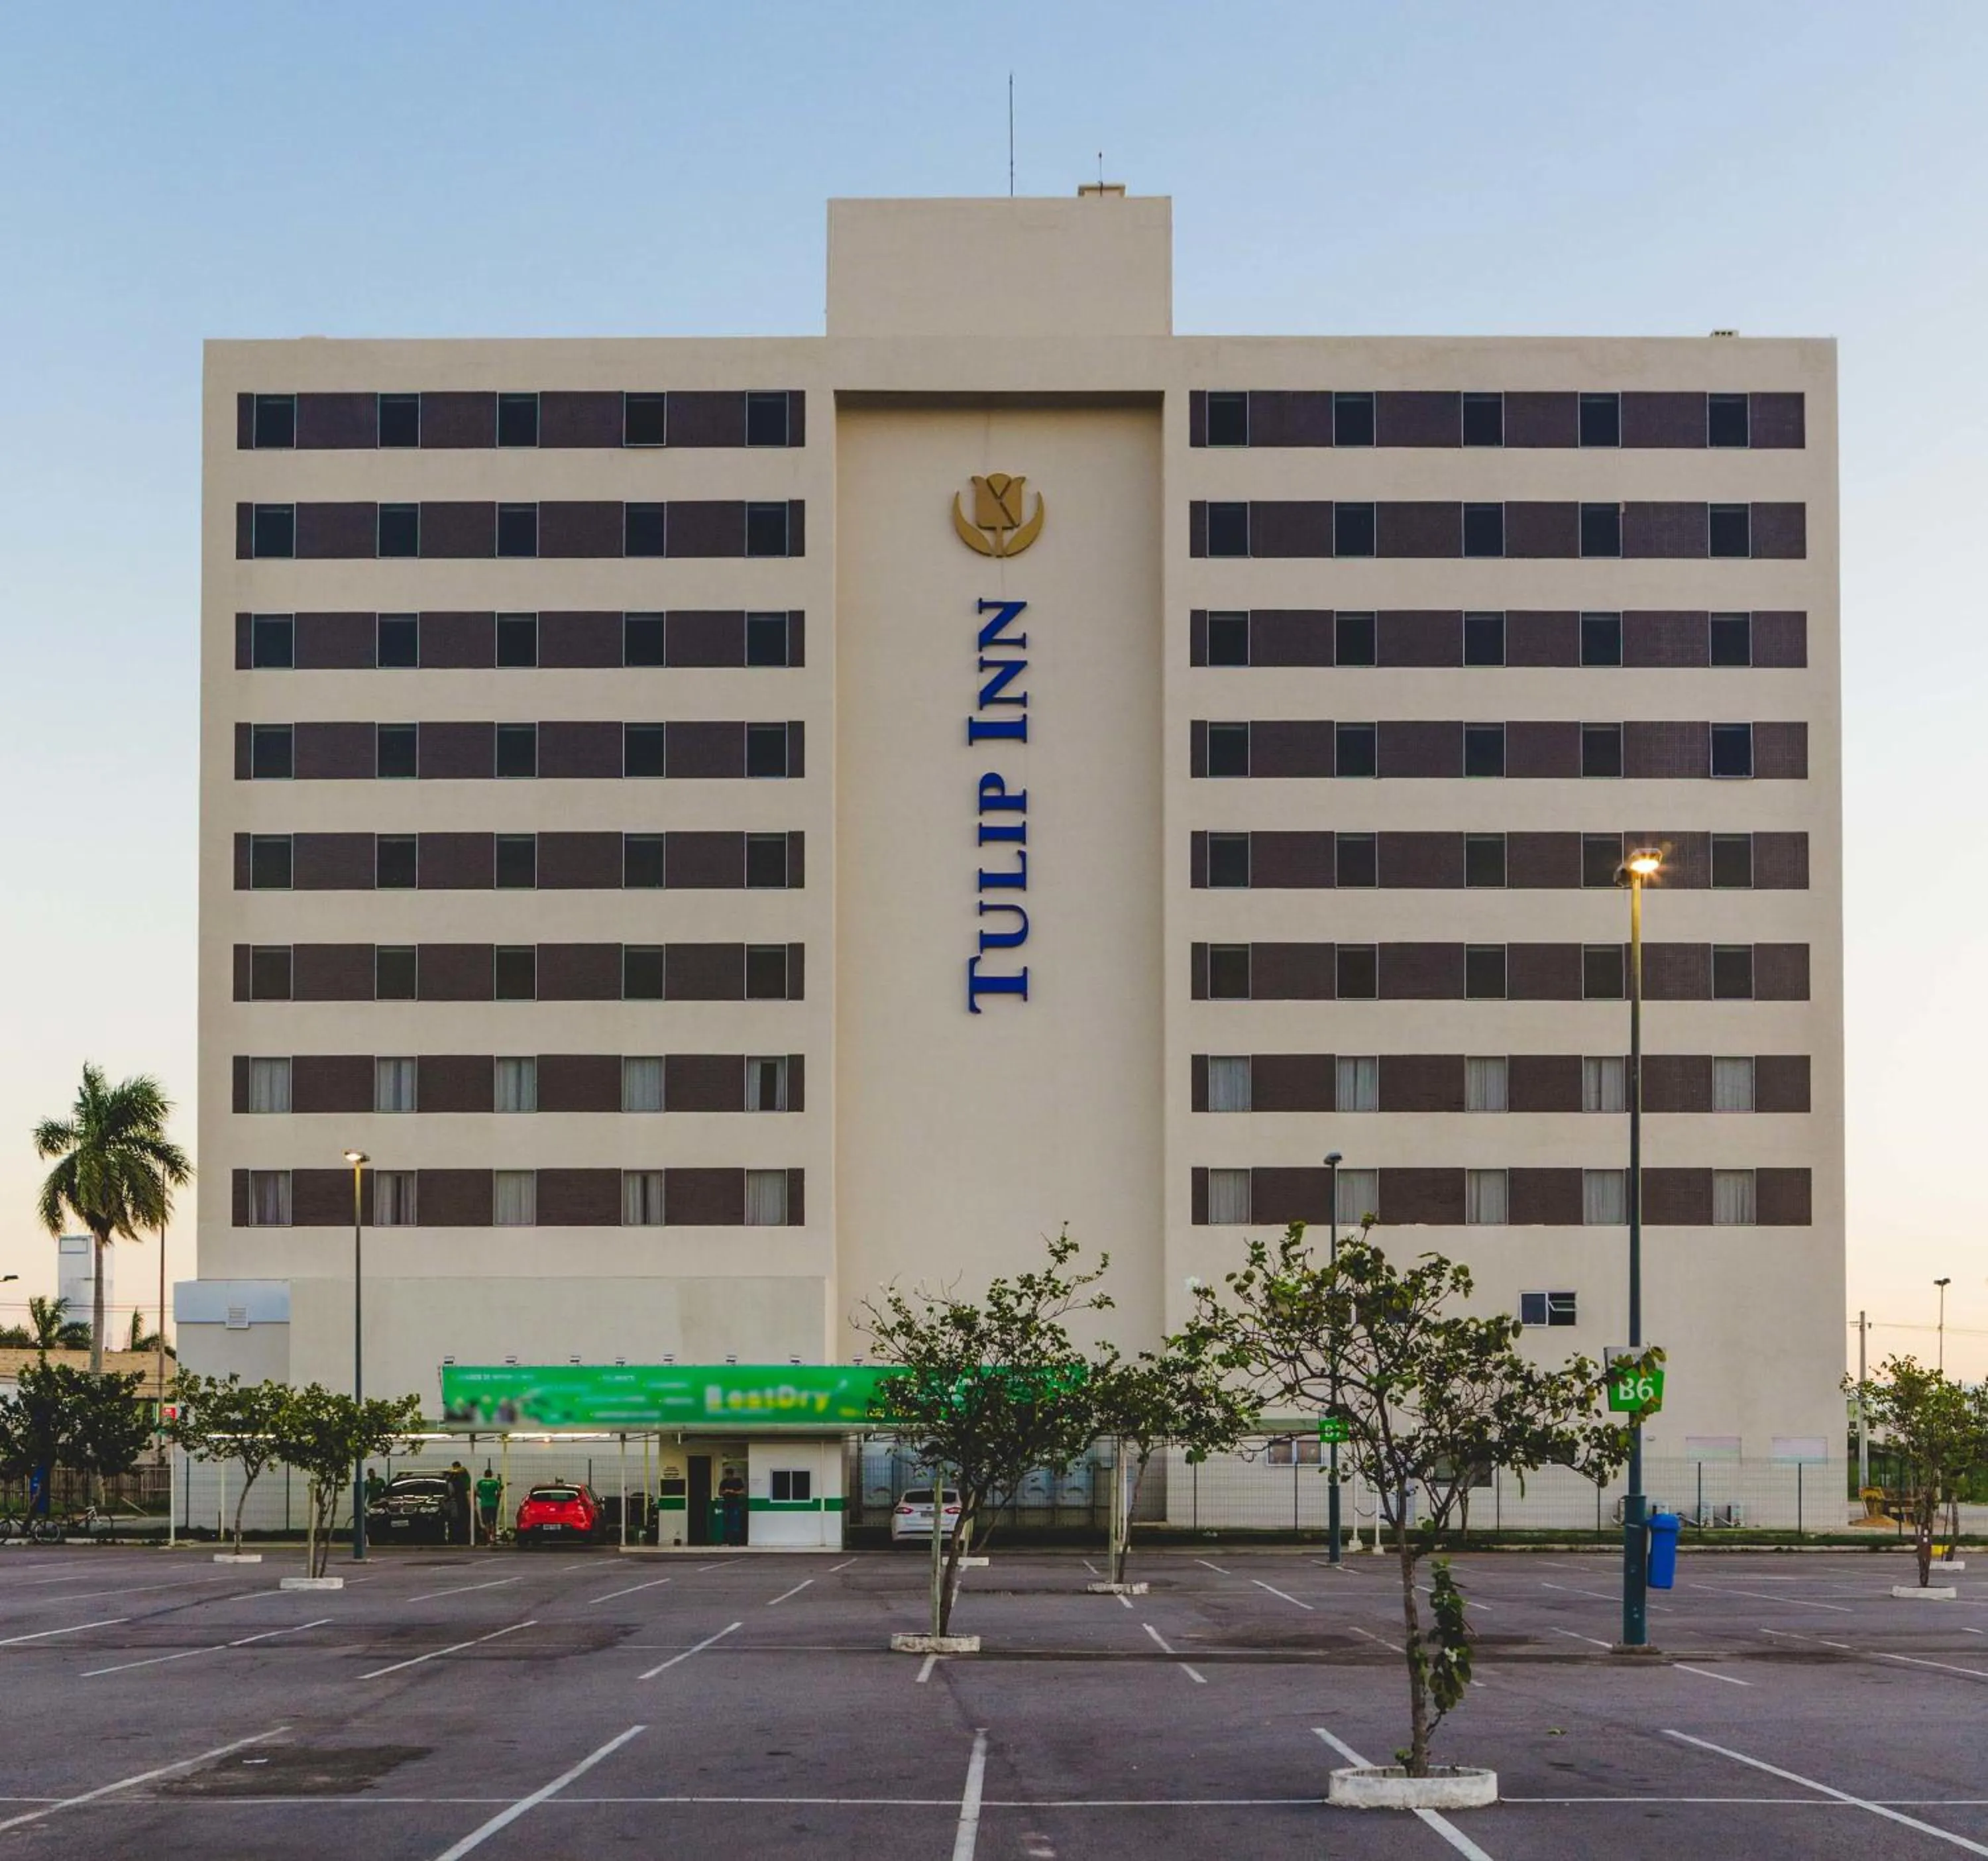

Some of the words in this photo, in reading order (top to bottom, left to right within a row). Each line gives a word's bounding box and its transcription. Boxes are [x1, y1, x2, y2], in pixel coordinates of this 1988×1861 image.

[967, 598, 1028, 746] INN
[967, 772, 1029, 1014] TULIP
[1619, 1377, 1655, 1401] B6
